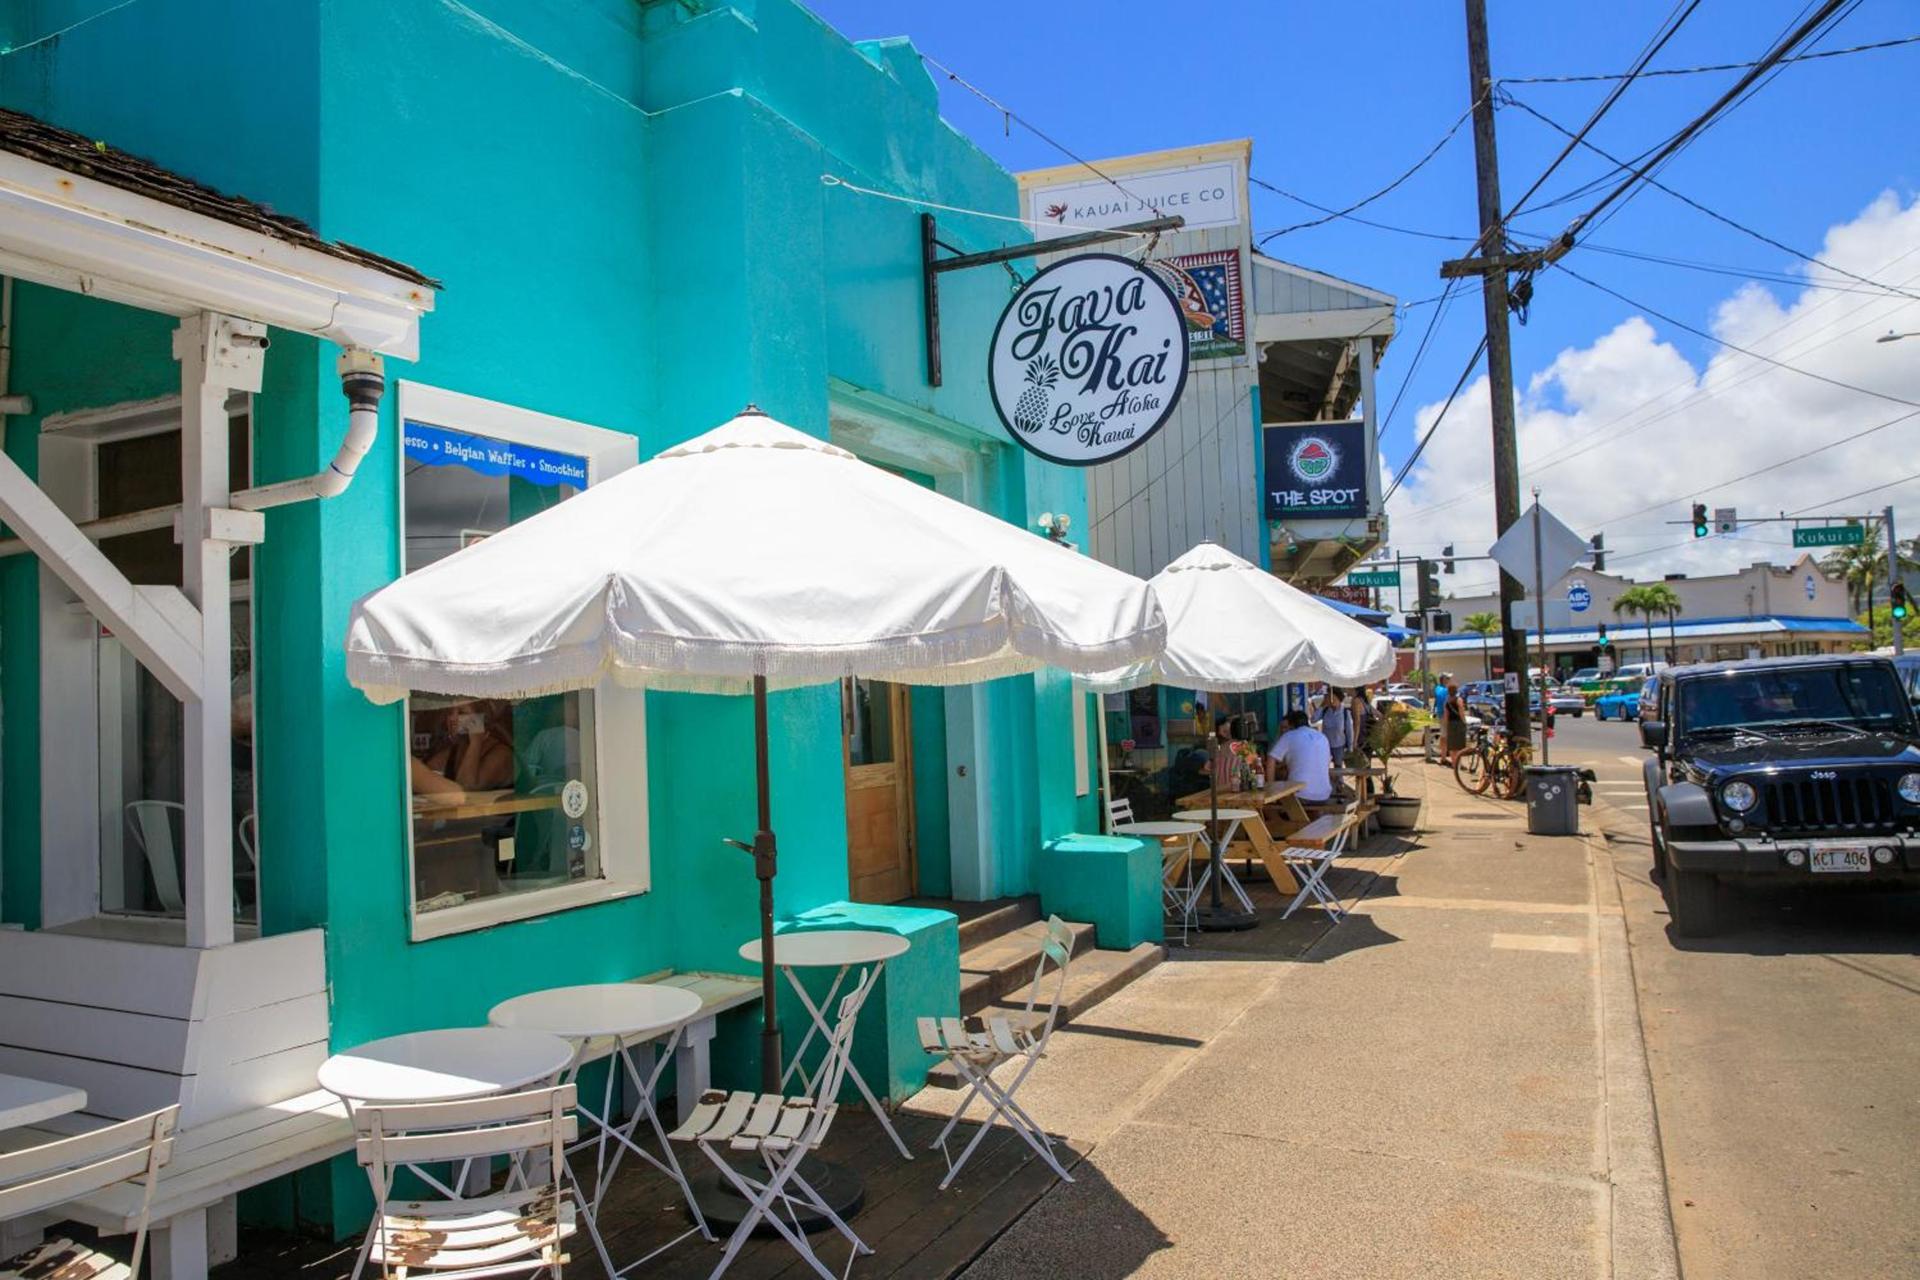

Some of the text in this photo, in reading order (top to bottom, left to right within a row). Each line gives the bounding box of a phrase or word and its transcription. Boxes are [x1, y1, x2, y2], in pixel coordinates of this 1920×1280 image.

[1074, 187, 1225, 219] KAUAI JUICE CO
[1011, 277, 1146, 361] Java
[1059, 323, 1171, 396] Kai
[1049, 389, 1160, 436] Love Aloha
[1076, 421, 1136, 448] Kauai
[404, 437, 585, 479] esso Belgian Waffles Smoothies
[1271, 489, 1360, 506] THE SPOT
[1796, 533, 1842, 545] Kukui
[1350, 575, 1385, 586] Kukui
[1810, 771, 1837, 780] Jeep
[1812, 851, 1868, 866] KCT 406
